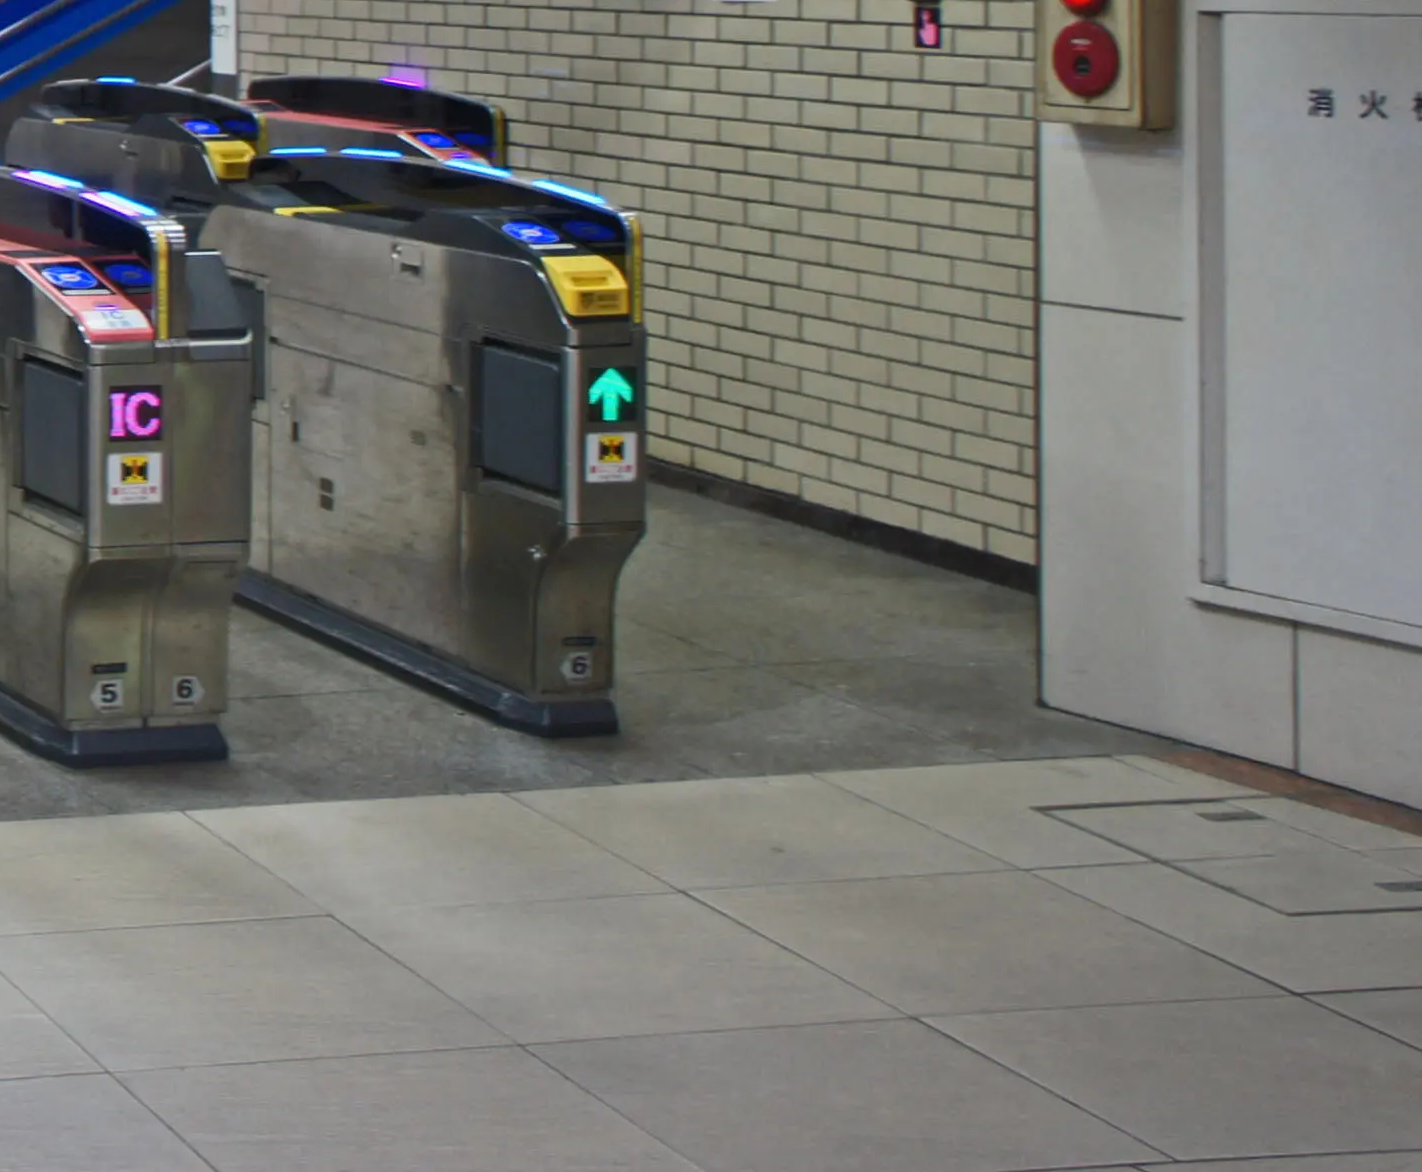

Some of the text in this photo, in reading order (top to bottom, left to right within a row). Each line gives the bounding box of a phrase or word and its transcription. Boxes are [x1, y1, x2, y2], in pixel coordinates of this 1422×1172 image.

[109, 391, 162, 437] IC
[571, 655, 588, 676] 6
[100, 678, 195, 703] 5 6
